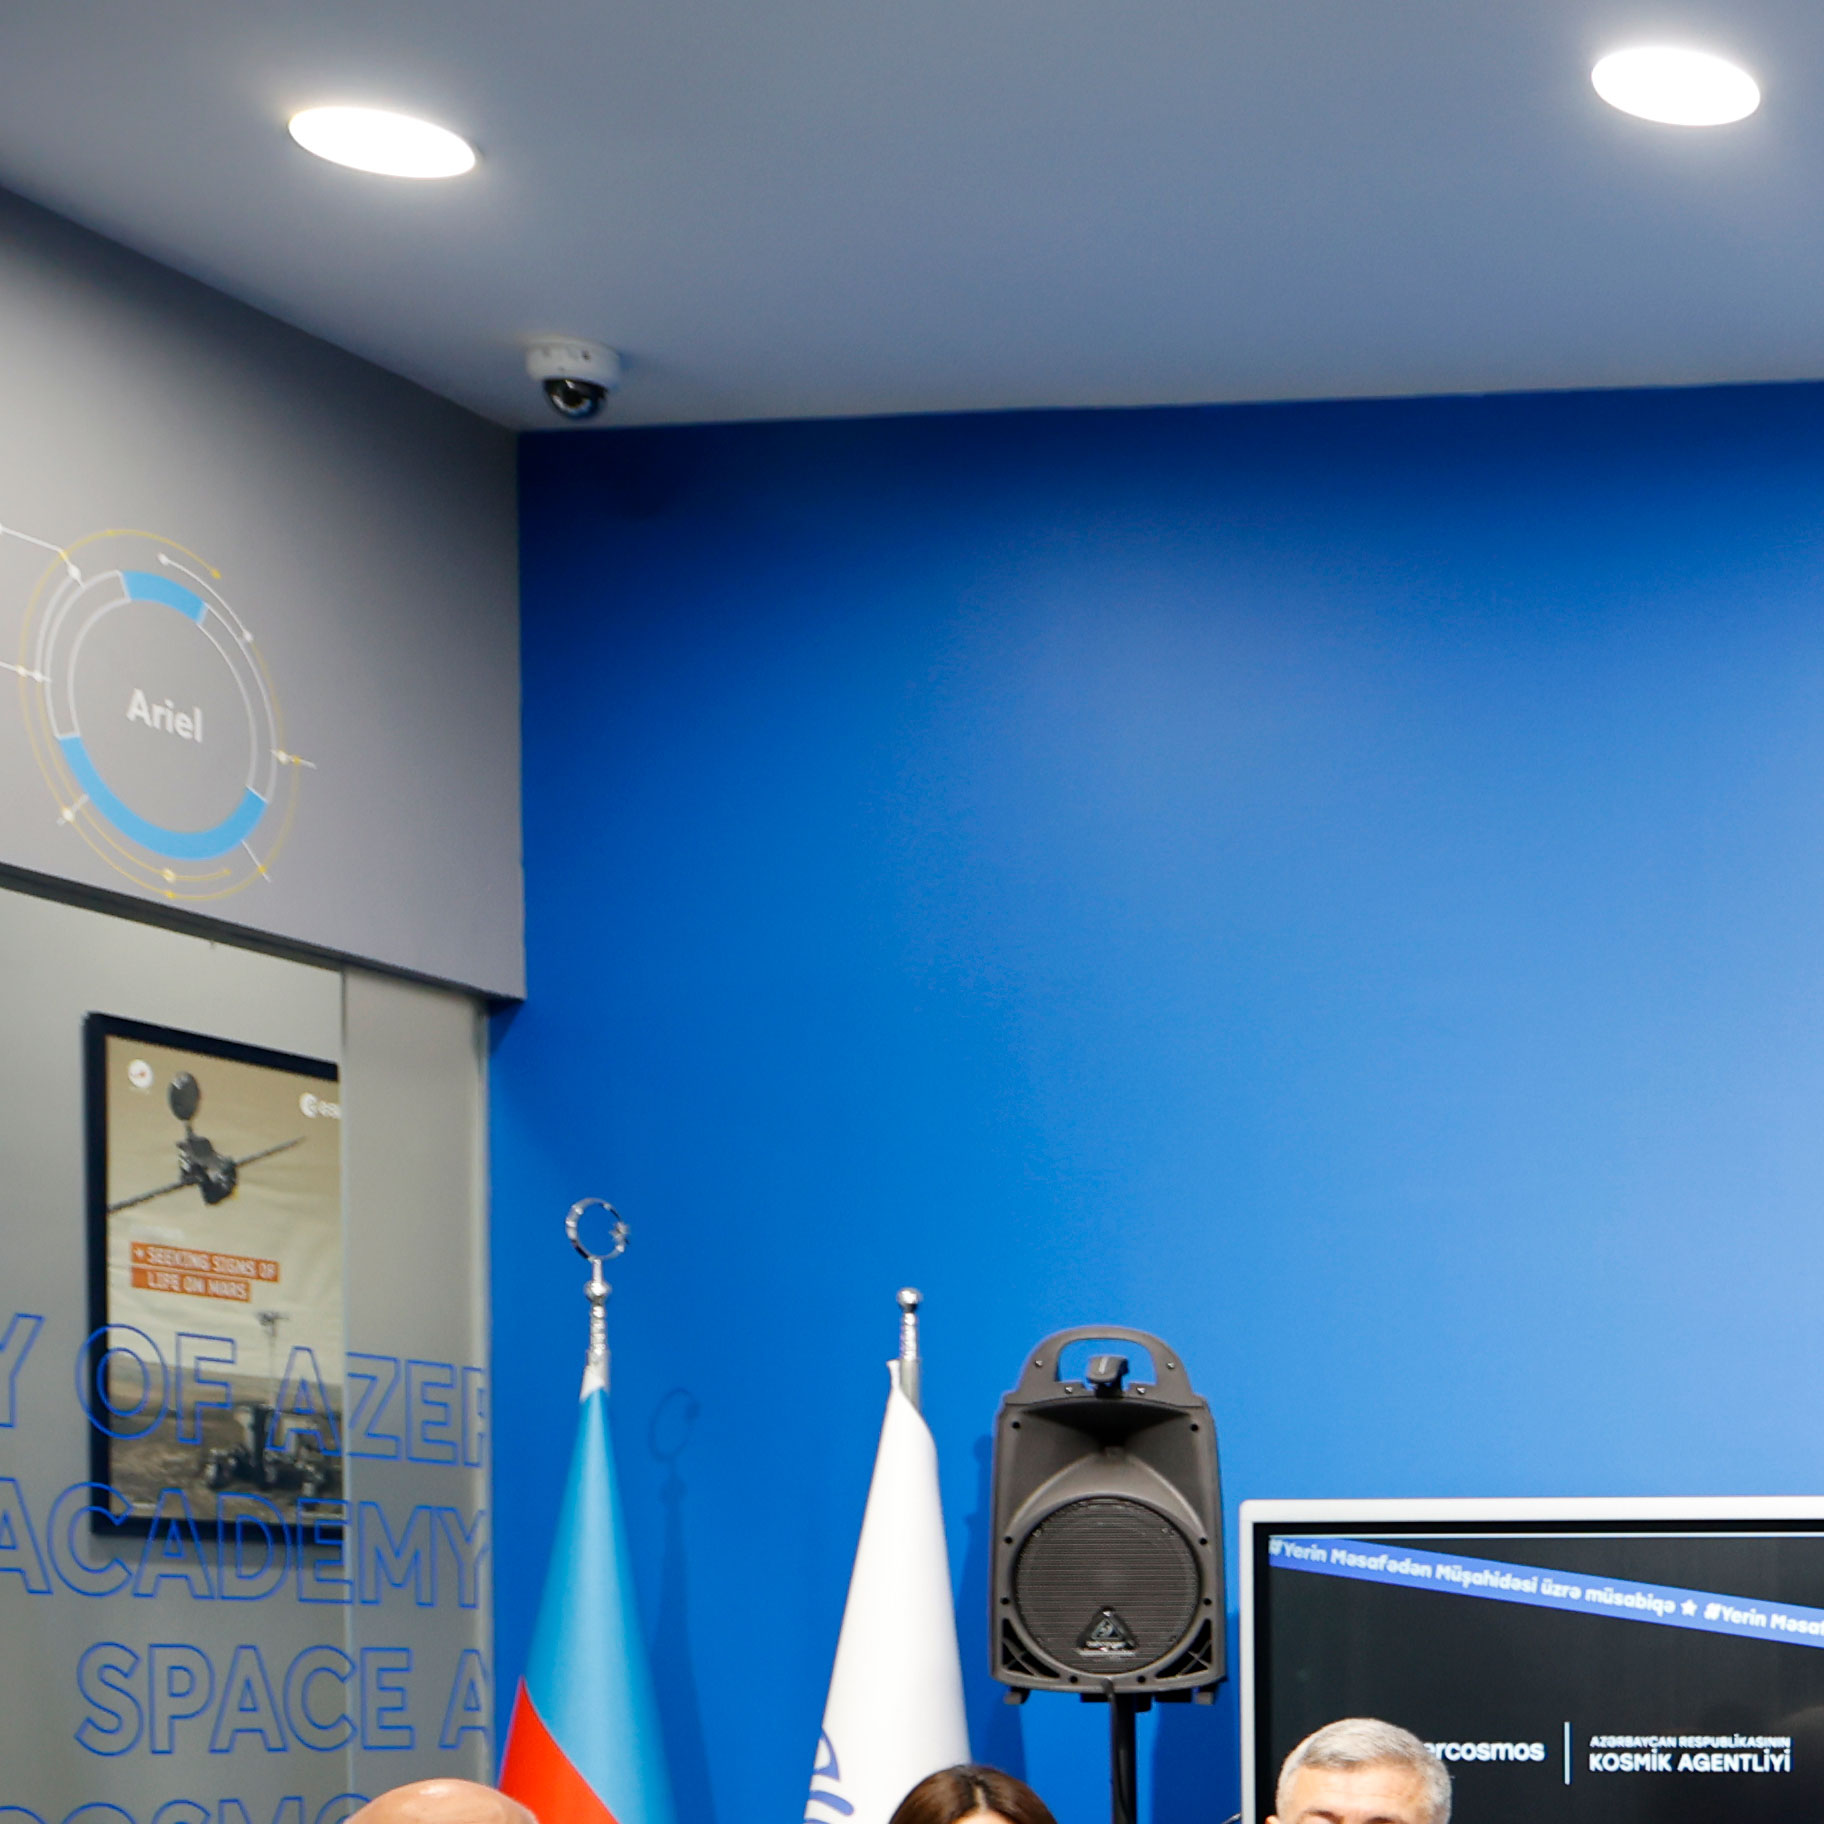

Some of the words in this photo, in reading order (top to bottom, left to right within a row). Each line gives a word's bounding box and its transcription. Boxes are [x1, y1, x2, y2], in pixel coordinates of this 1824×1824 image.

[126, 688, 203, 744] Ariel
[75, 1323, 238, 1445] OF
[74, 1641, 415, 1757] SPACE
[1589, 1748, 1673, 1773] KOSMİK
[1677, 1749, 1791, 1773] AGENTLİYİ
